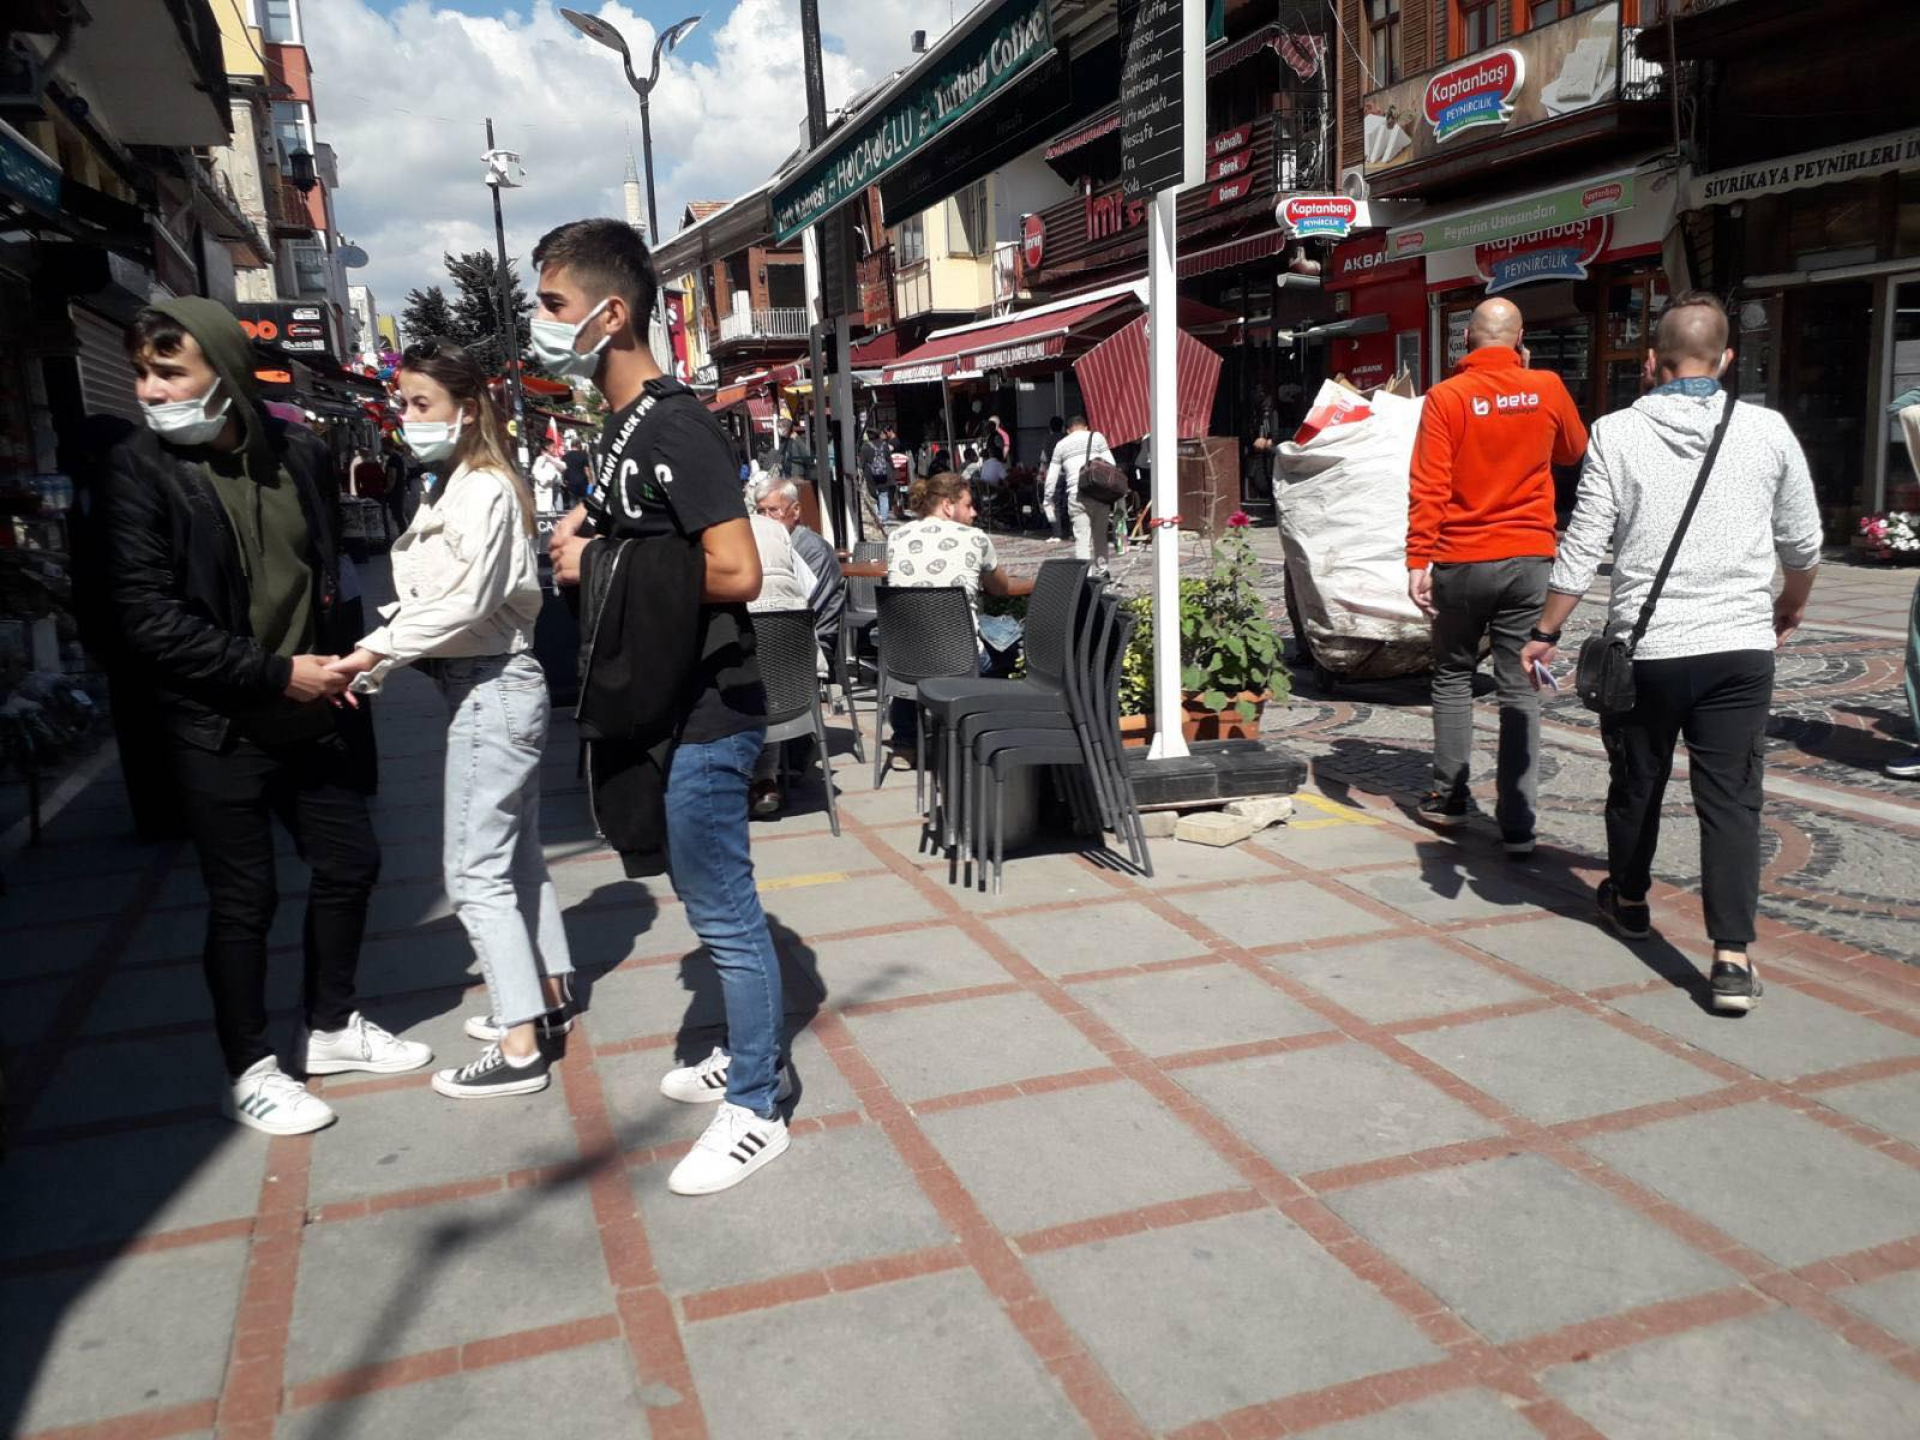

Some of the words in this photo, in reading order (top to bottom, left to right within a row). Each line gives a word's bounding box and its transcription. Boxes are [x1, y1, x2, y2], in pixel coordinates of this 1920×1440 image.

[1432, 64, 1508, 103] Kaptanbaşı
[1705, 167, 1789, 198] SİVRİKAYA
[1793, 138, 1902, 181] PEYNİRLERİ
[1291, 202, 1351, 216] Kaptanbaşı
[1343, 251, 1392, 273] AKBA
[1505, 253, 1568, 279] PEYNİRCİLİK
[1352, 363, 1383, 375] AKBANK
[1496, 391, 1538, 408] beta
[611, 414, 641, 455] BLACK
